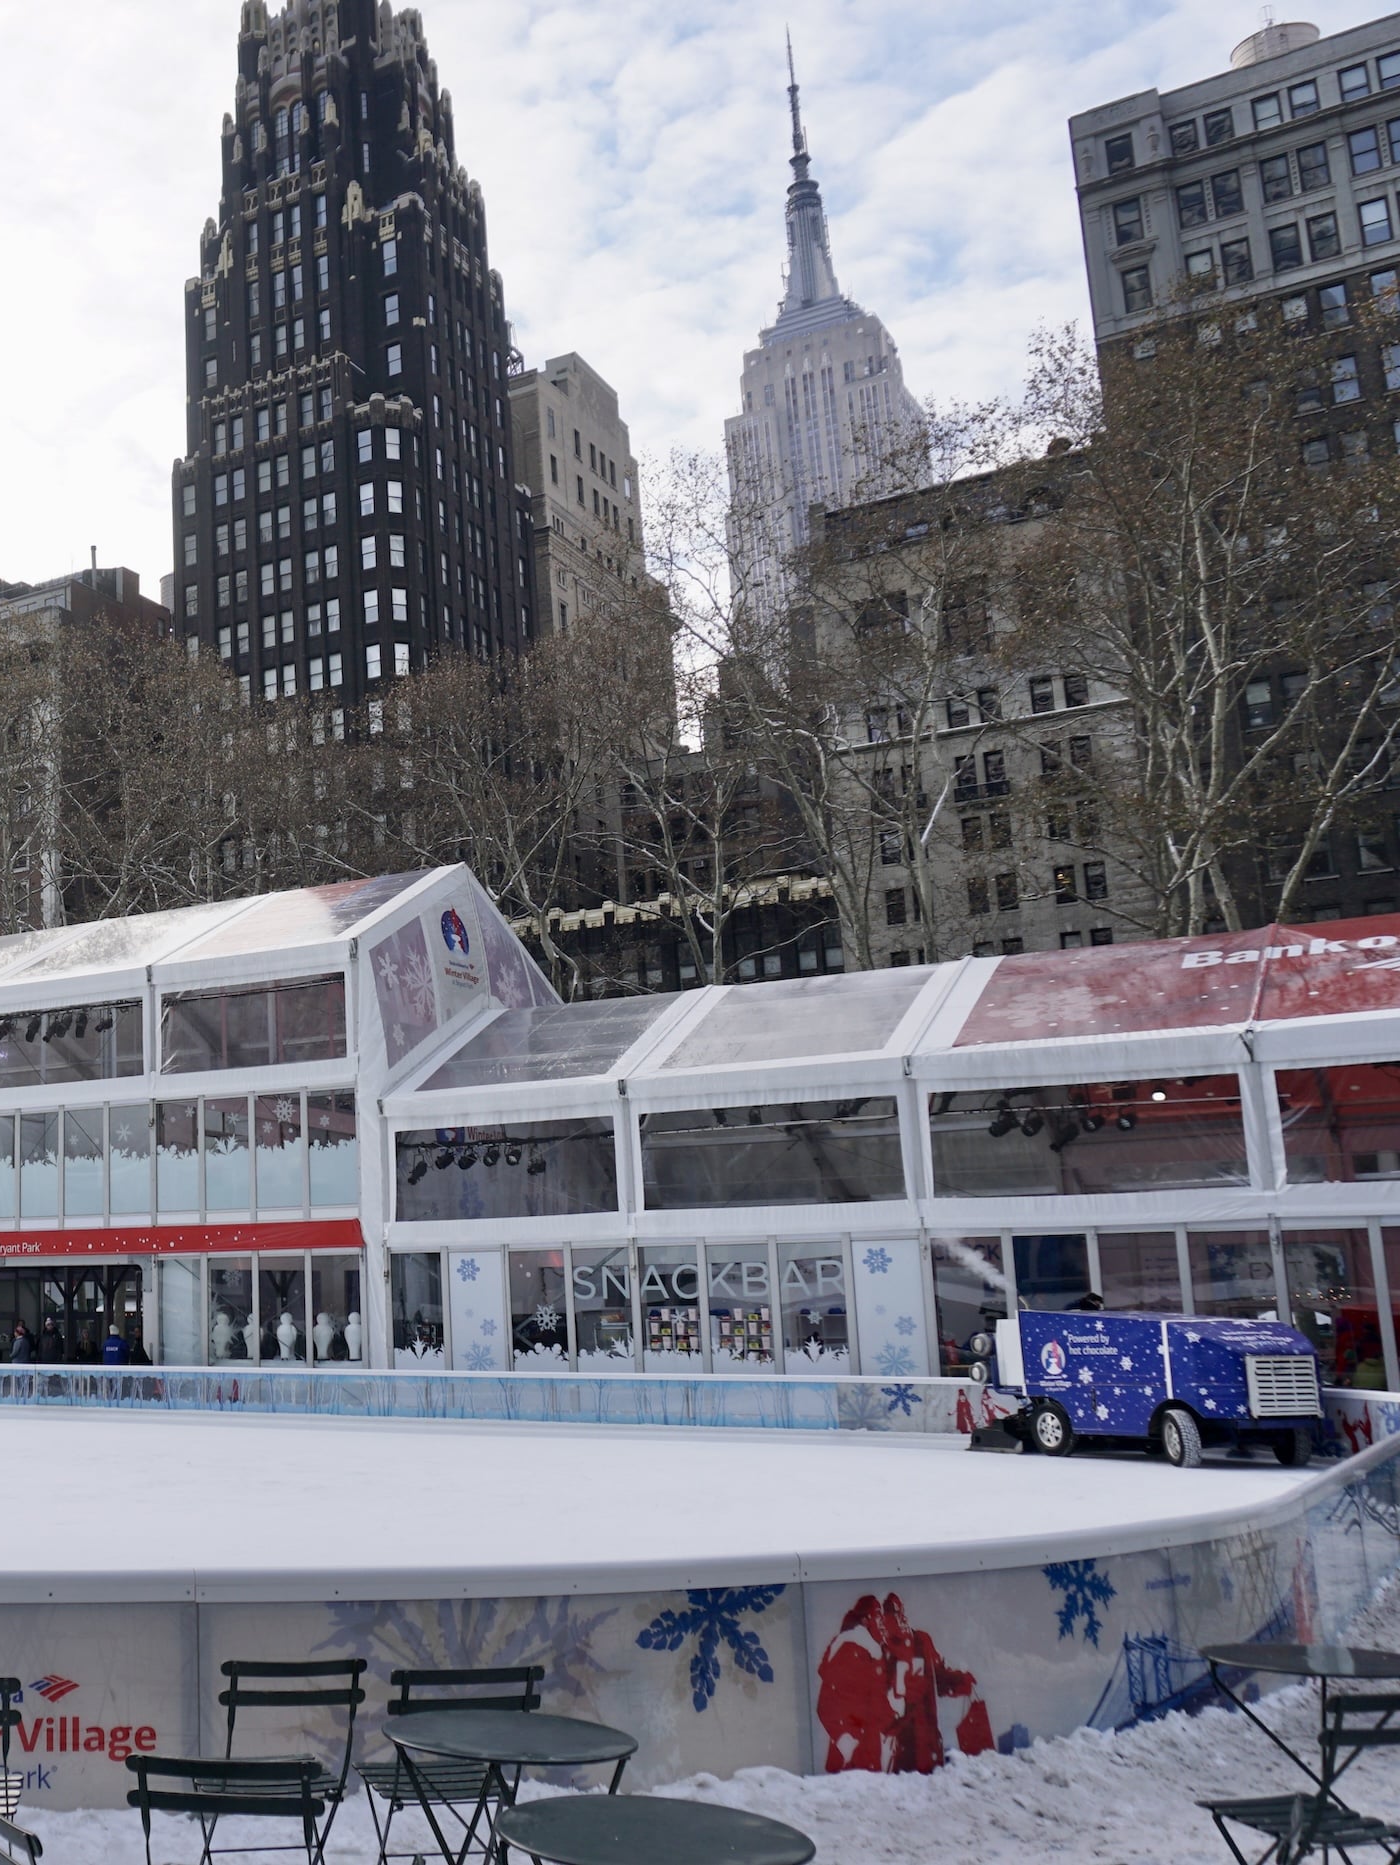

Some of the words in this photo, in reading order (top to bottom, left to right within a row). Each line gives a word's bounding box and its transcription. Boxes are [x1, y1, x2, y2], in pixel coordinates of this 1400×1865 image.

[1181, 937, 1348, 968] Bank
[21, 1241, 41, 1253] Park
[573, 1259, 845, 1301] SNACKBAR
[1067, 1333, 1100, 1344] Powered
[1100, 1334, 1110, 1346] by
[1068, 1345, 1082, 1355] hot
[1082, 1345, 1119, 1356] chocolate
[15, 1716, 157, 1762] Village
